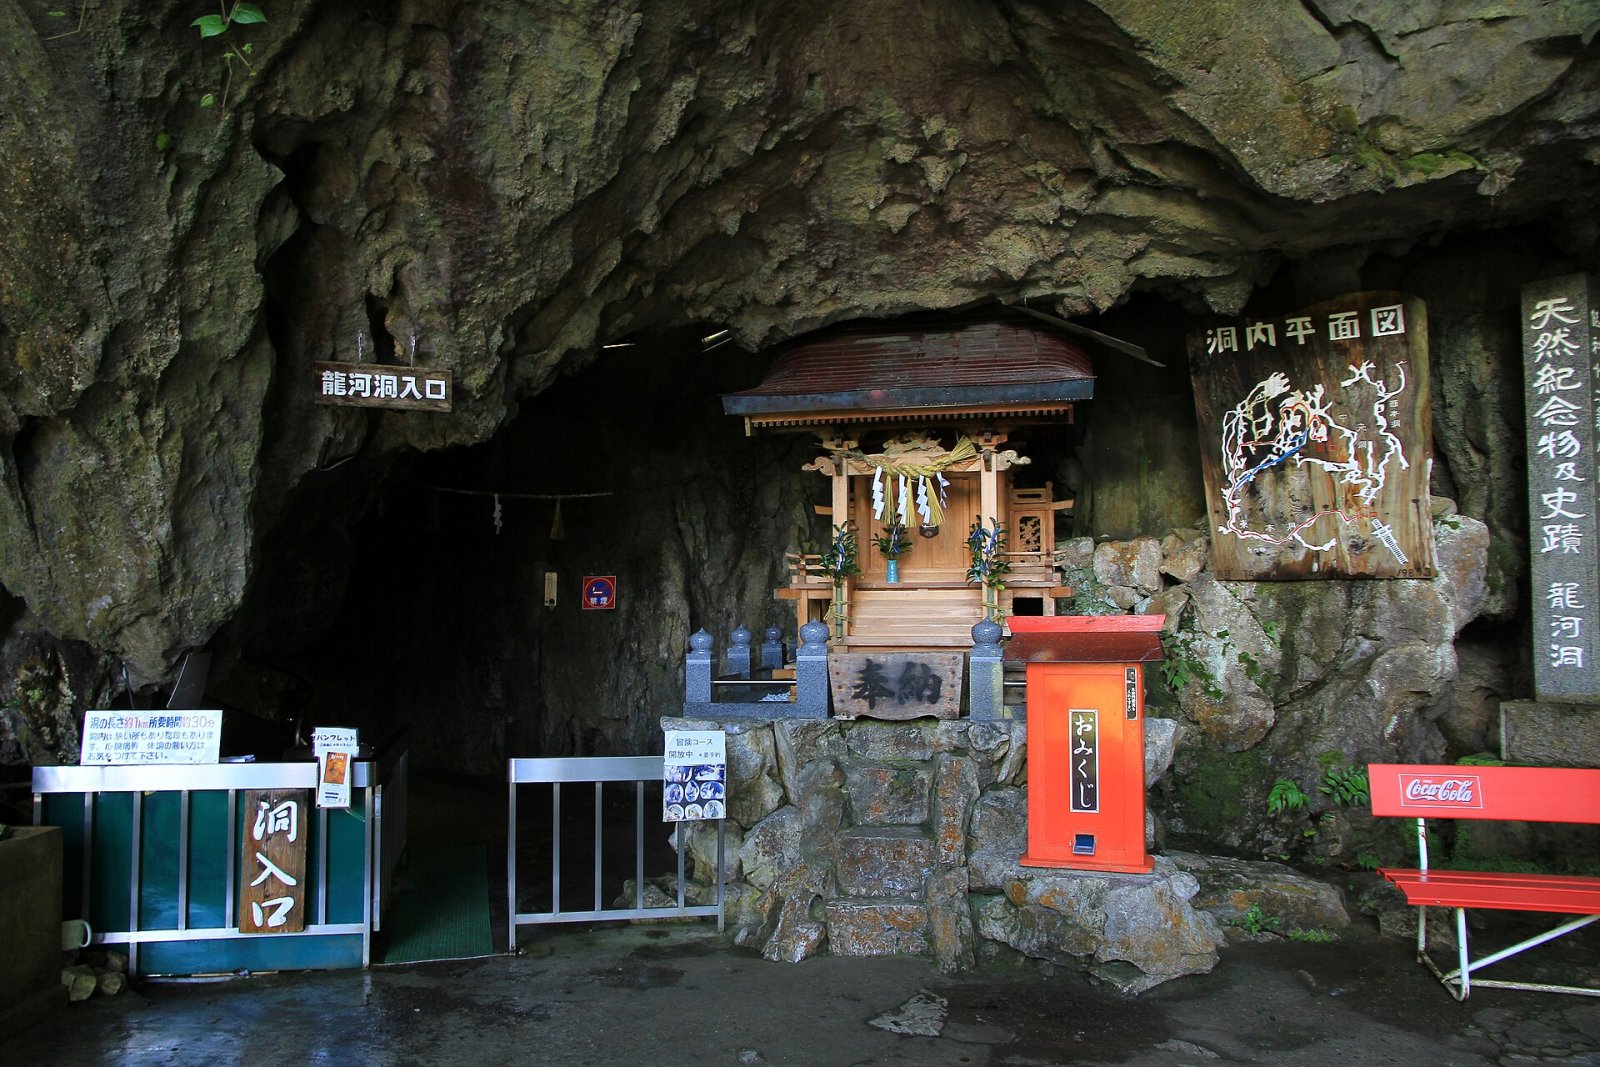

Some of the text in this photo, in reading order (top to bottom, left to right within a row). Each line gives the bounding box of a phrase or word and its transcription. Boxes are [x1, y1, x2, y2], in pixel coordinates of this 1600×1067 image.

[1206, 304, 1406, 354] 洞内平面図
[321, 370, 446, 400] 龍河洞入口
[590, 597, 608, 605] 禁煙
[1546, 581, 1586, 669] 龍河洞
[850, 658, 943, 710] 奉納
[668, 750, 694, 759] 開放中
[676, 738, 713, 747] 冒険コース
[1073, 713, 1094, 808] おみくじ
[1406, 778, 1474, 803] Coca-Cola
[250, 800, 298, 928] 洞入口
